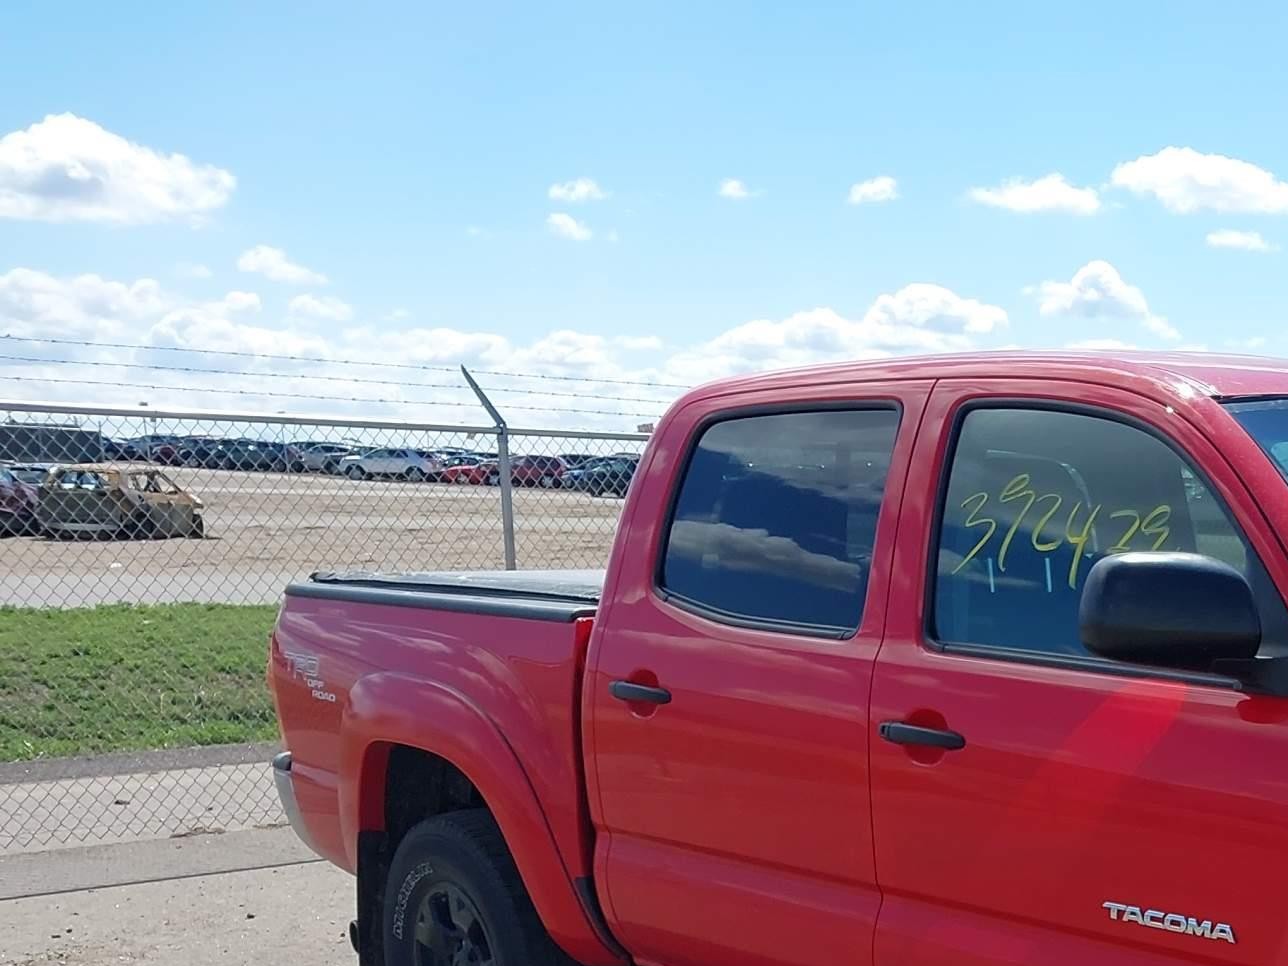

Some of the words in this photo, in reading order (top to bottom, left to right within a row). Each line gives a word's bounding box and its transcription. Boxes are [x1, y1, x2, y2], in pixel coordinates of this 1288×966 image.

[307, 679, 324, 689] OFF
[312, 690, 336, 702] ROAD
[1102, 901, 1236, 944] TACOMA
